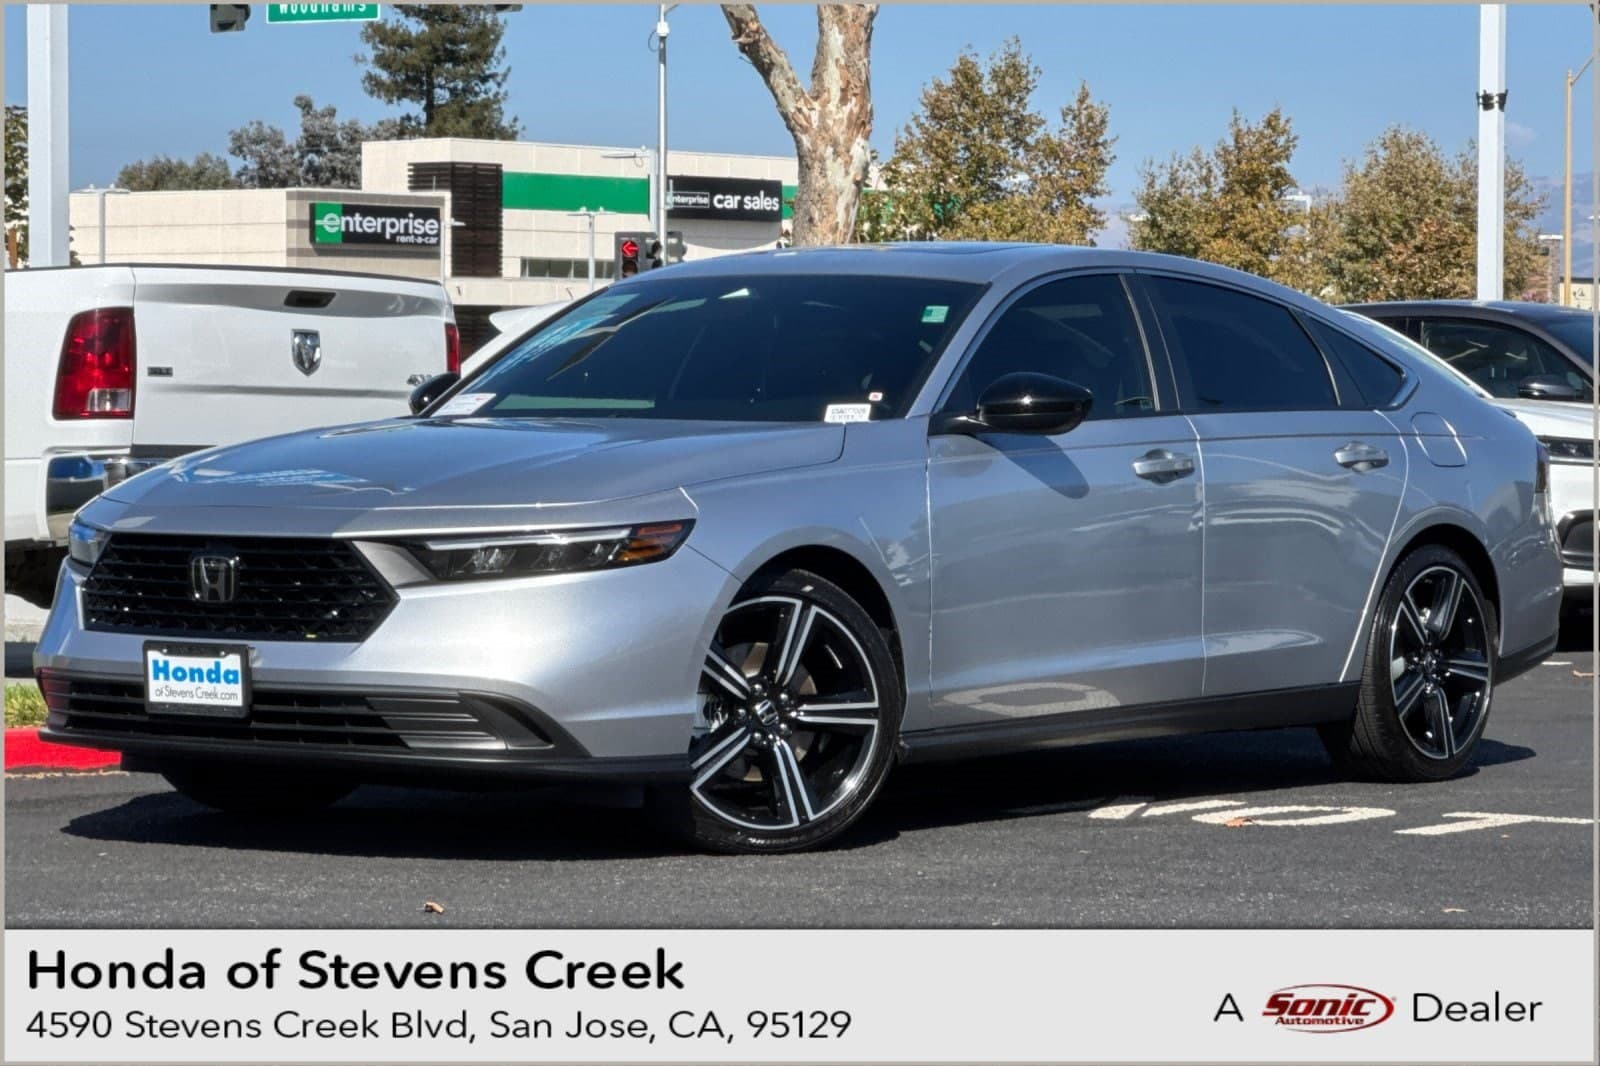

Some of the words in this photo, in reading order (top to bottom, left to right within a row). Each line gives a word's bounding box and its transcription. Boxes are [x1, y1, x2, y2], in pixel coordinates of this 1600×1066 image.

[713, 194, 741, 209] car
[743, 189, 780, 211] sales
[316, 212, 439, 239] enterprise
[396, 234, 439, 244] rent-a-car
[152, 659, 239, 684] Honda
[155, 686, 163, 697] of
[164, 685, 194, 698] Stevens
[195, 686, 239, 701] Creek.com
